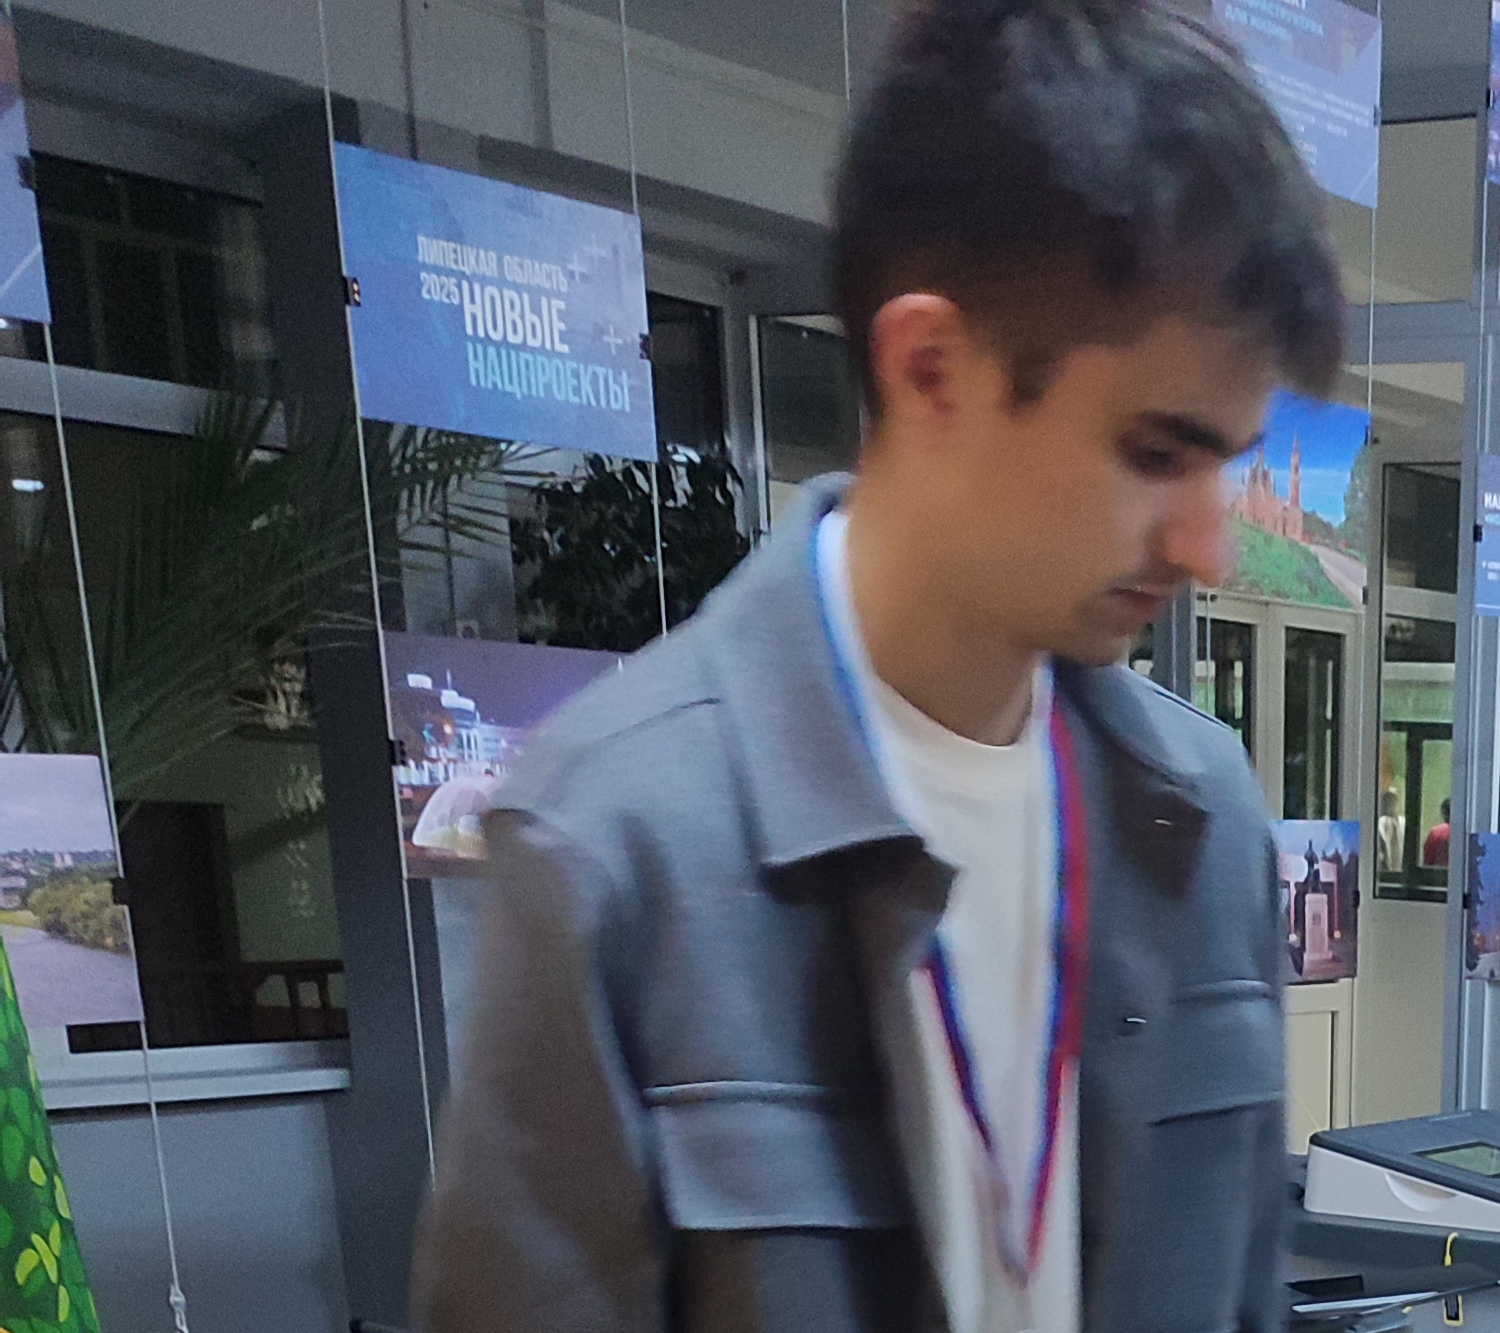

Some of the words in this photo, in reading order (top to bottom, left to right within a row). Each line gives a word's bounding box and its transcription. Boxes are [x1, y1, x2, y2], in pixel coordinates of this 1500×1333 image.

[417, 235, 498, 277] ЛИПЕЦКАЯ
[504, 255, 568, 292] ОБЛАСТЬ
[420, 273, 460, 305] 2025
[462, 281, 570, 354] НОВЫЕ
[467, 341, 631, 413] НАЦПРОЕКТЫ
